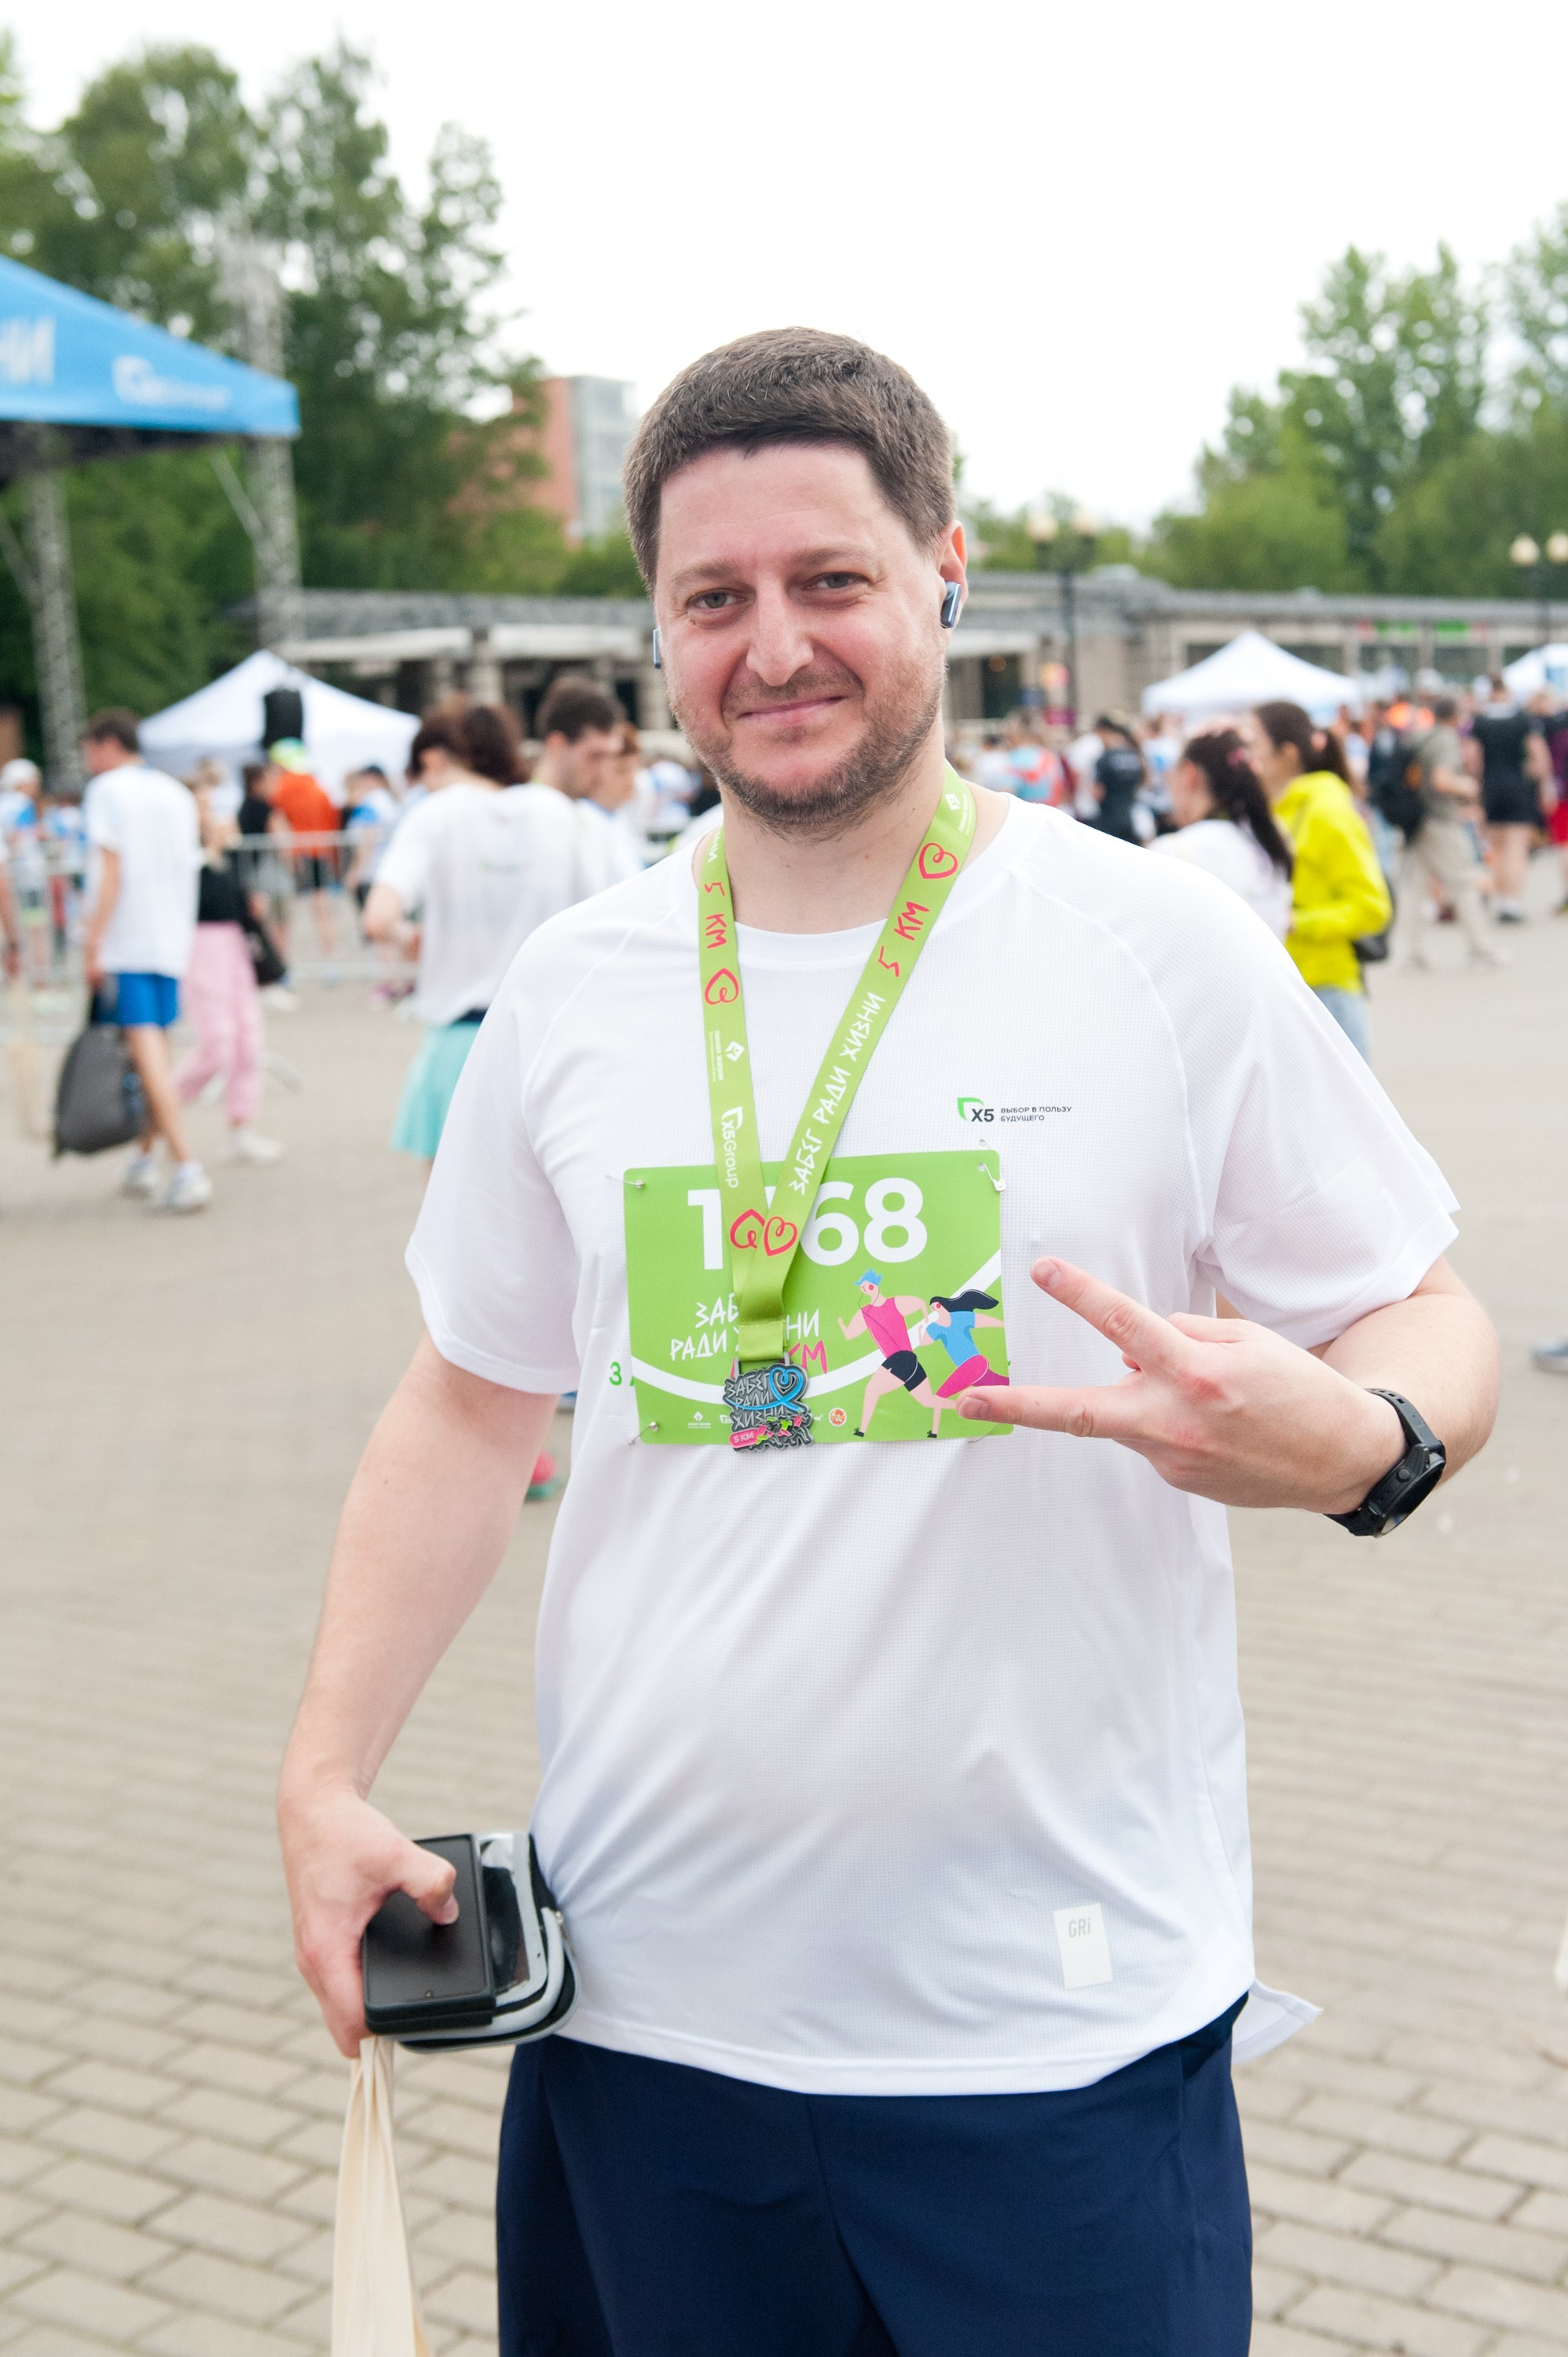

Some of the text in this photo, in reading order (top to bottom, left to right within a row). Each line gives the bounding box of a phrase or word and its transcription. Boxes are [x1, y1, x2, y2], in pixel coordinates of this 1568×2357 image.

[704, 882, 726, 896] 5
[787, 1127, 823, 1196] ЗАБЕГ
[811, 1065, 852, 1125] РАДИ
[838, 991, 886, 1062] ЖИЗНИ
[877, 945, 900, 977] 5
[971, 1109, 995, 1123] X5
[720, 1119, 739, 1189] X5Group
[687, 1177, 928, 1271] 168
[694, 1292, 738, 1329] ЗАБ
[669, 1329, 727, 1362] РАДИ
[727, 1372, 771, 1399] ЗАБЕГ
[1068, 1917, 1091, 1938] GRi
